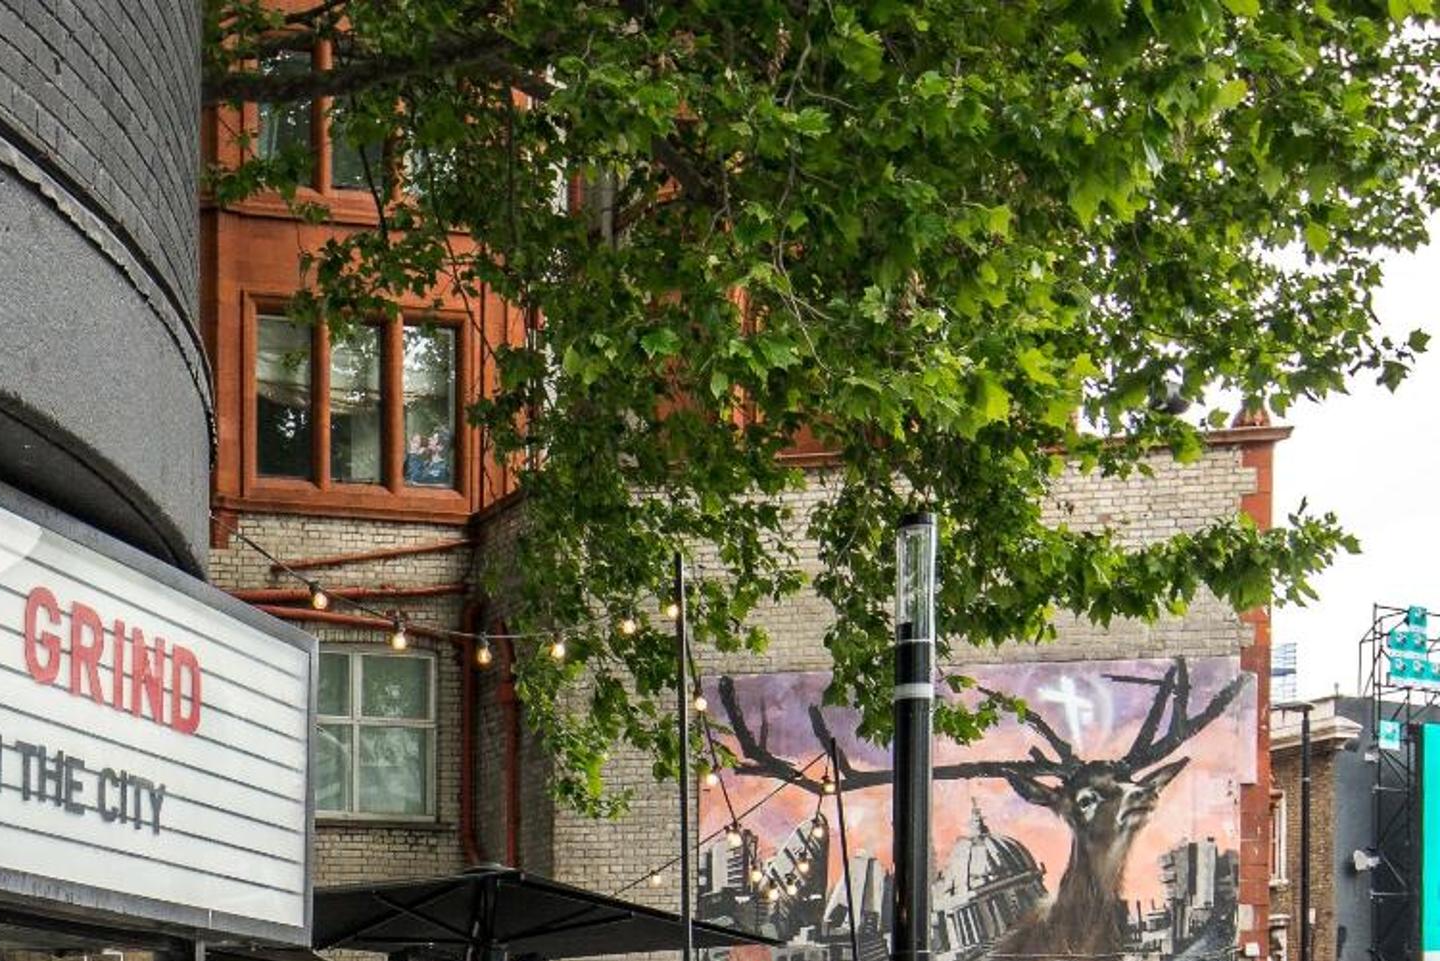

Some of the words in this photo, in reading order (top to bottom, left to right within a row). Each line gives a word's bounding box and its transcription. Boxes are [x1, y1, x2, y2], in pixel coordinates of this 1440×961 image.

[24, 586, 203, 735] GRIND
[13, 739, 86, 817] THE
[97, 766, 166, 836] CITY
